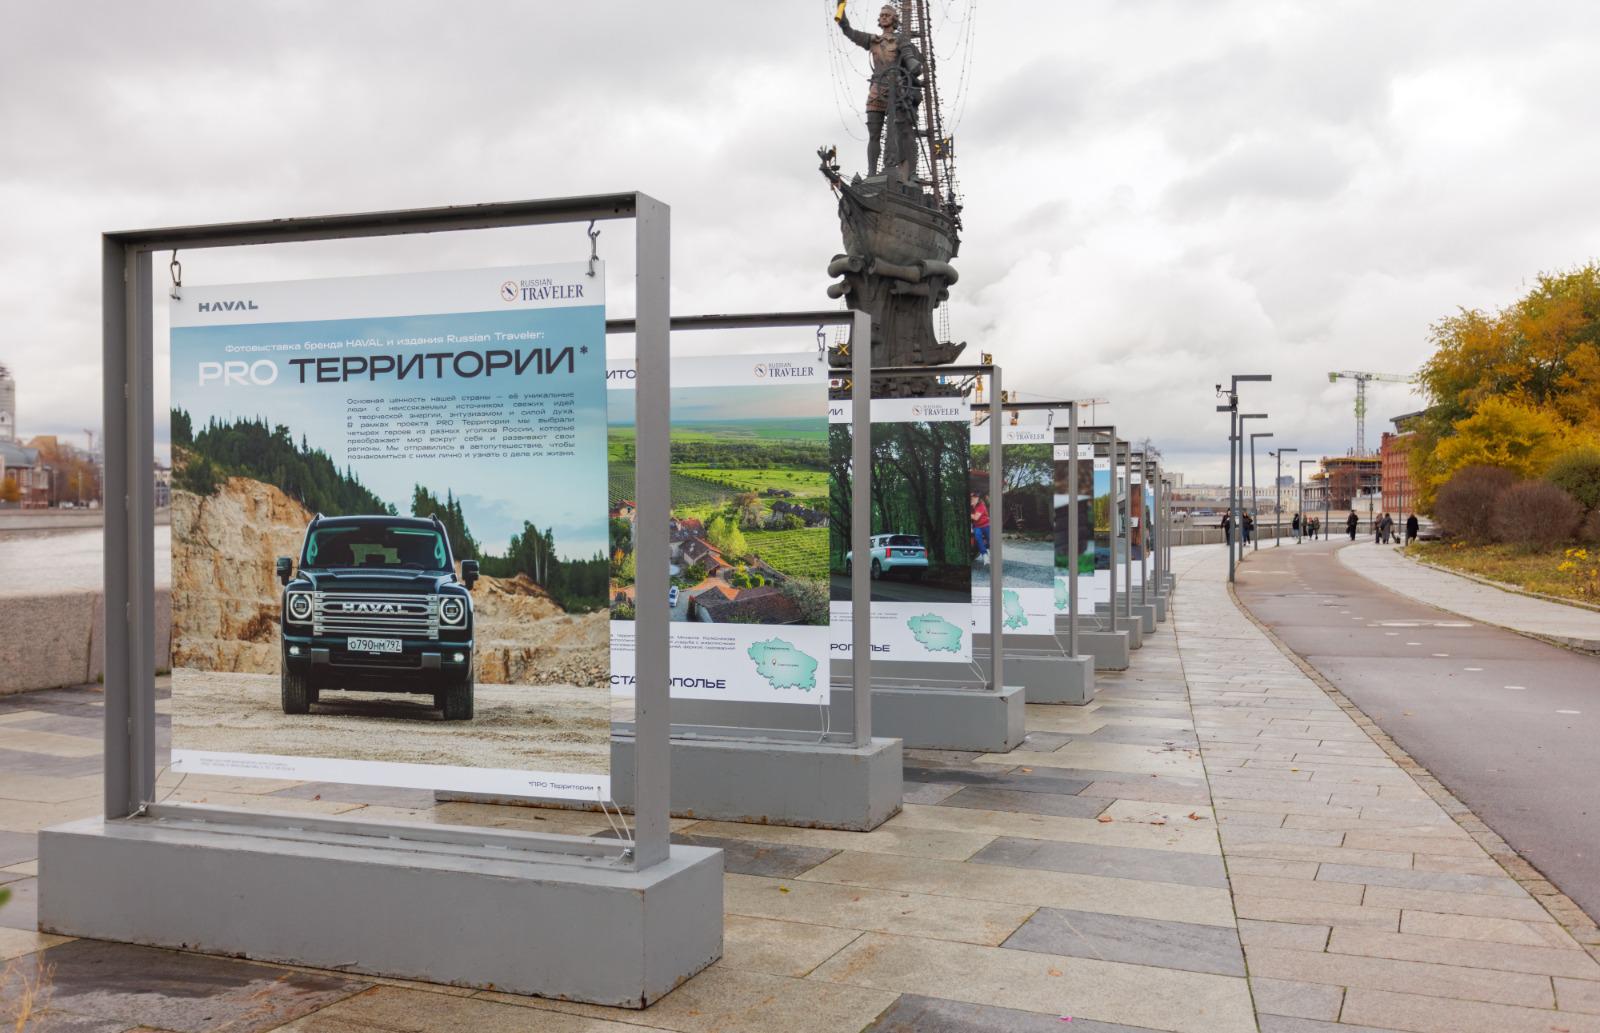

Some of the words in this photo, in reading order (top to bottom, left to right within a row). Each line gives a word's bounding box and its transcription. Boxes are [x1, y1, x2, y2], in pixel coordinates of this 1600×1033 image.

[521, 279, 552, 287] RUSSIAN
[521, 285, 584, 301] TRAVELER
[198, 300, 259, 312] HAVAL
[225, 343, 301, 353] Фотовыставка
[304, 341, 343, 351] бренда
[346, 339, 383, 347] HAVAL
[397, 336, 444, 346] издания
[447, 334, 491, 343] Russian
[494, 331, 545, 340] Traveler:
[199, 359, 279, 386] PRO
[769, 367, 814, 377] TRAVELER
[553, 399, 575, 407] идей
[924, 408, 959, 416] TRAVELER
[430, 428, 460, 436] разных
[342, 602, 409, 615] HAVAL
[549, 782, 594, 791] Территории
